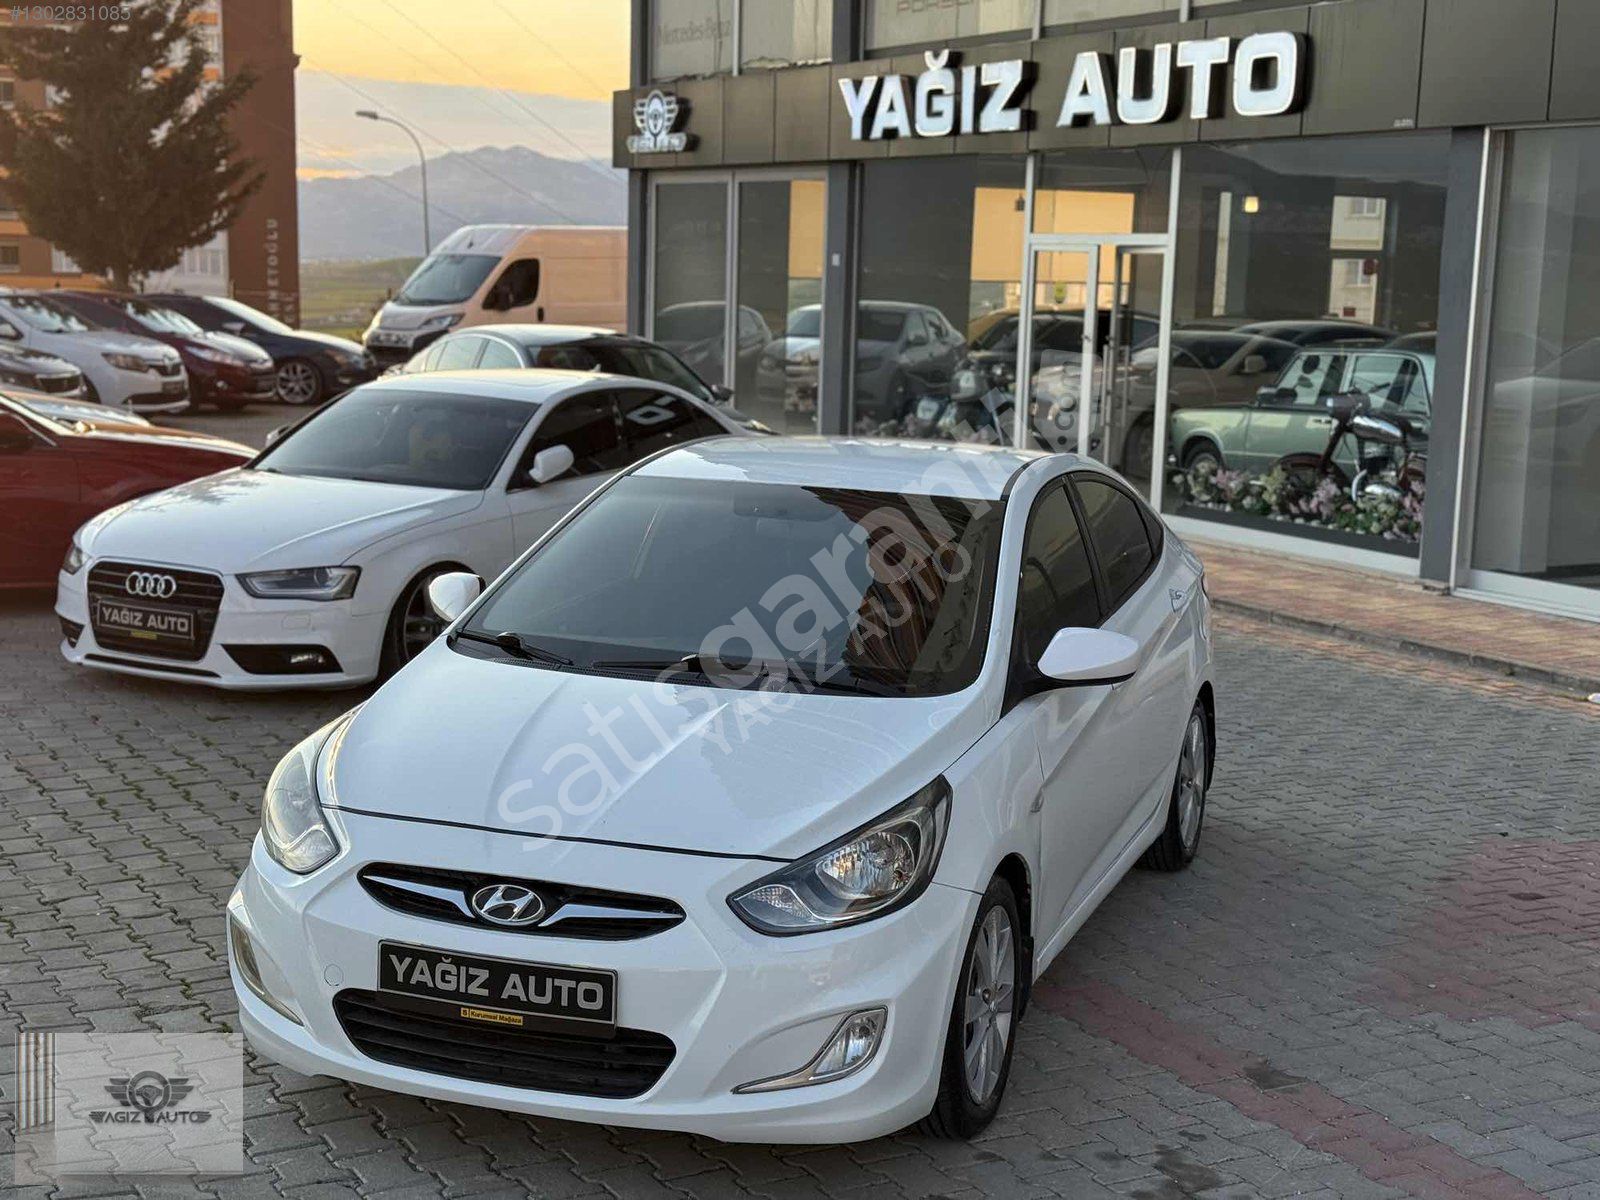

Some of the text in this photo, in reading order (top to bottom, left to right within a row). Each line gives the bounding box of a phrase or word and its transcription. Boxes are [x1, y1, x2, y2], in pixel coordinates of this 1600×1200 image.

[838, 31, 1298, 141] YAĞIZ AUTO
[146, 614, 189, 633] AUTO
[388, 953, 605, 1011] YAĞIZ AUTO
